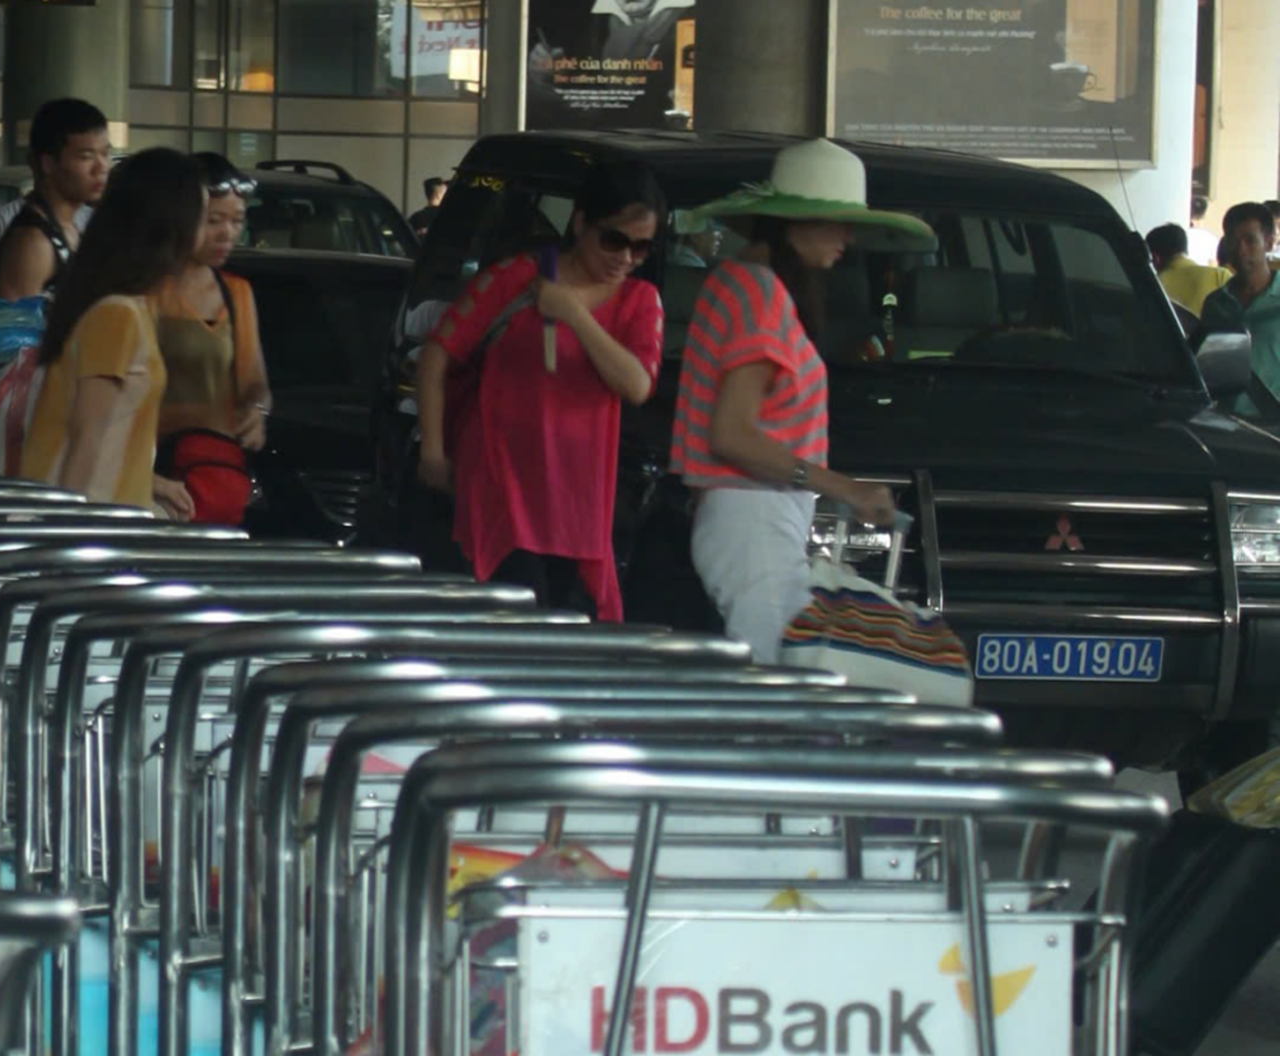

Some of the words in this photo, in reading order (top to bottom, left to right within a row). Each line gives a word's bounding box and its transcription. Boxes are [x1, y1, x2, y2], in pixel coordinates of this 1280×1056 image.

[880, 6, 901, 19] The
[905, 6, 944, 20] coffee
[946, 7, 963, 20] for
[966, 8, 987, 20] the
[989, 8, 1022, 23] great
[580, 57, 600, 70] của
[602, 58, 631, 70] danh
[982, 640, 1155, 676] 80A-019.04
[590, 986, 936, 1056] HDBank
